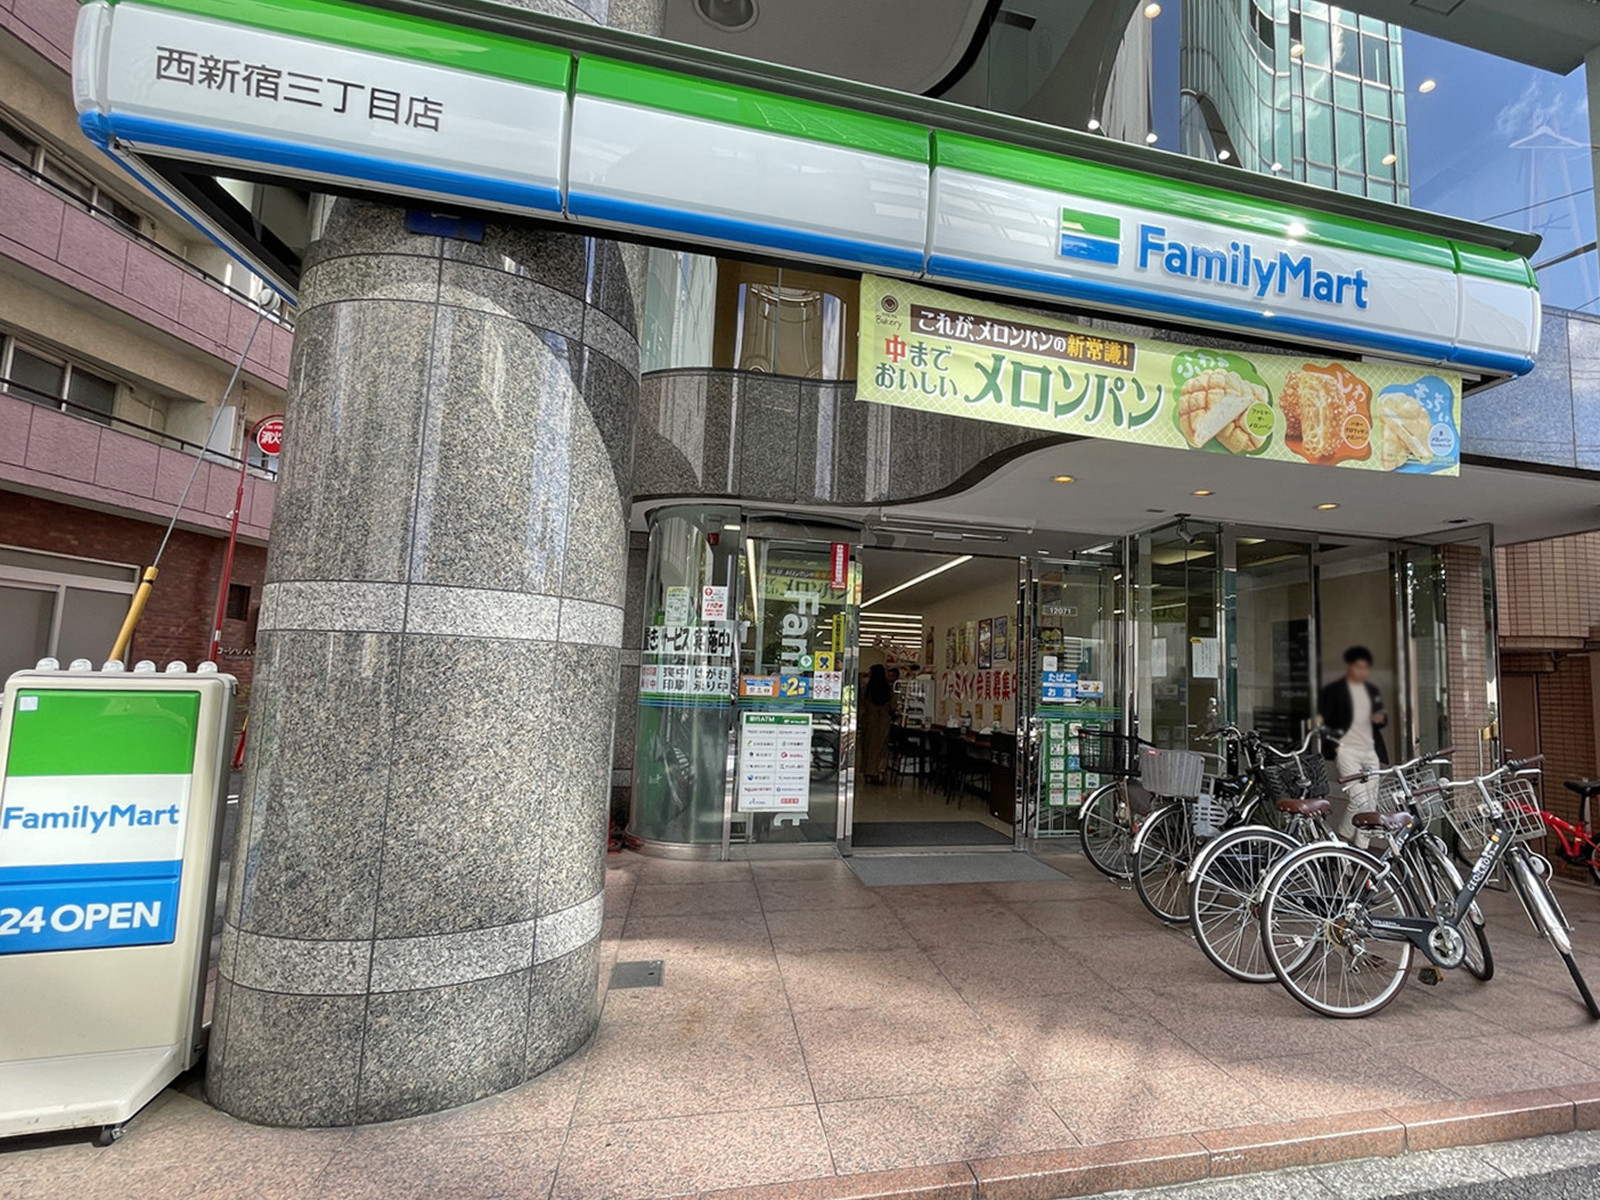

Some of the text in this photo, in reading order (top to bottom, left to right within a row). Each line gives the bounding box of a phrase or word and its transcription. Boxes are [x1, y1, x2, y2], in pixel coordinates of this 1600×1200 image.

[156, 46, 443, 132] 西新宿三丁目店
[1138, 223, 1368, 309] FamilyMart
[884, 334, 952, 372] 中まで
[875, 362, 958, 398] おいしい
[963, 353, 1163, 430] メロンパン
[1047, 672, 1072, 683] たばこ
[2, 804, 180, 834] FamilyMart
[0, 901, 161, 935] 24 OPEN
